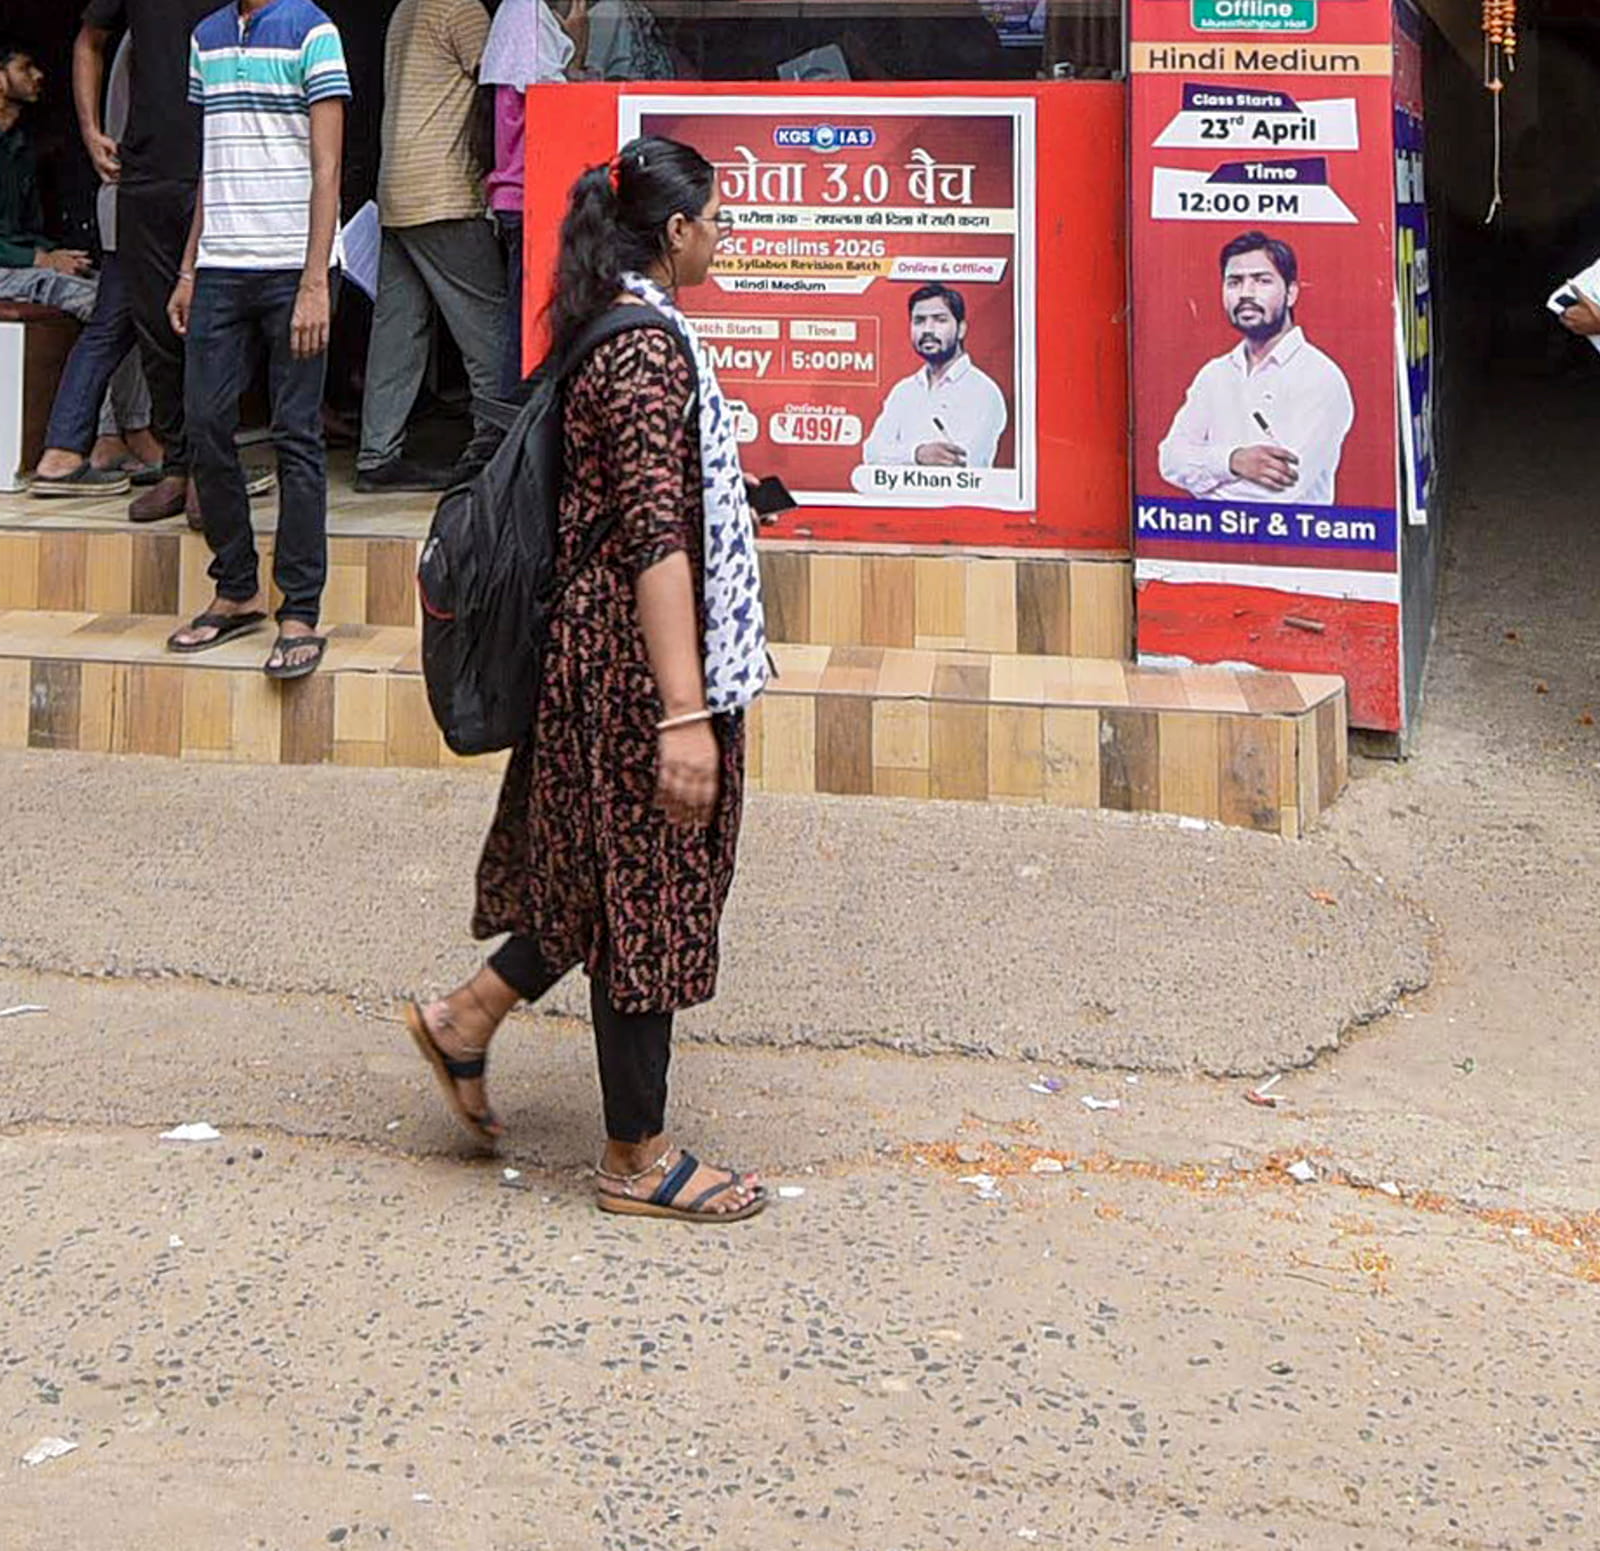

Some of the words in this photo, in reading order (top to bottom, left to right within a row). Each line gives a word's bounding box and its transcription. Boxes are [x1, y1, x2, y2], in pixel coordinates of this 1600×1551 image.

[1215, 0, 1293, 18] Offline
[1149, 49, 1225, 71] Hindi
[1235, 48, 1360, 72] Medium
[1192, 93, 1234, 107] Class
[1236, 94, 1283, 108] Starts
[779, 130, 811, 144] KGS
[840, 130, 872, 145] IAS
[1200, 115, 1245, 140] 23rd
[1252, 118, 1316, 145] April
[715, 146, 807, 203] जेता
[904, 148, 976, 204] बैच
[1244, 164, 1297, 180] Time
[1178, 192, 1250, 213] 12:00
[1258, 194, 1299, 214] PM
[752, 237, 829, 256] Prelims
[834, 239, 886, 257] 2026
[736, 258, 788, 271] Syllabus
[791, 259, 844, 271] Revision
[846, 260, 881, 271] Batch
[898, 262, 938, 274] Online
[941, 263, 949, 274] &
[953, 262, 994, 275] Offline
[735, 279, 768, 291] Hindi
[771, 279, 826, 292] Medium
[726, 322, 763, 336] Starts
[806, 324, 837, 336] Time
[709, 345, 772, 377] May
[791, 350, 875, 371] 5:00PM
[874, 469, 898, 491] By
[904, 470, 951, 488] Khan
[957, 472, 982, 489] Sir
[1138, 506, 1212, 532] Khan
[1220, 509, 1259, 534] Sir
[1267, 513, 1288, 536] &
[1296, 514, 1376, 541] Team
